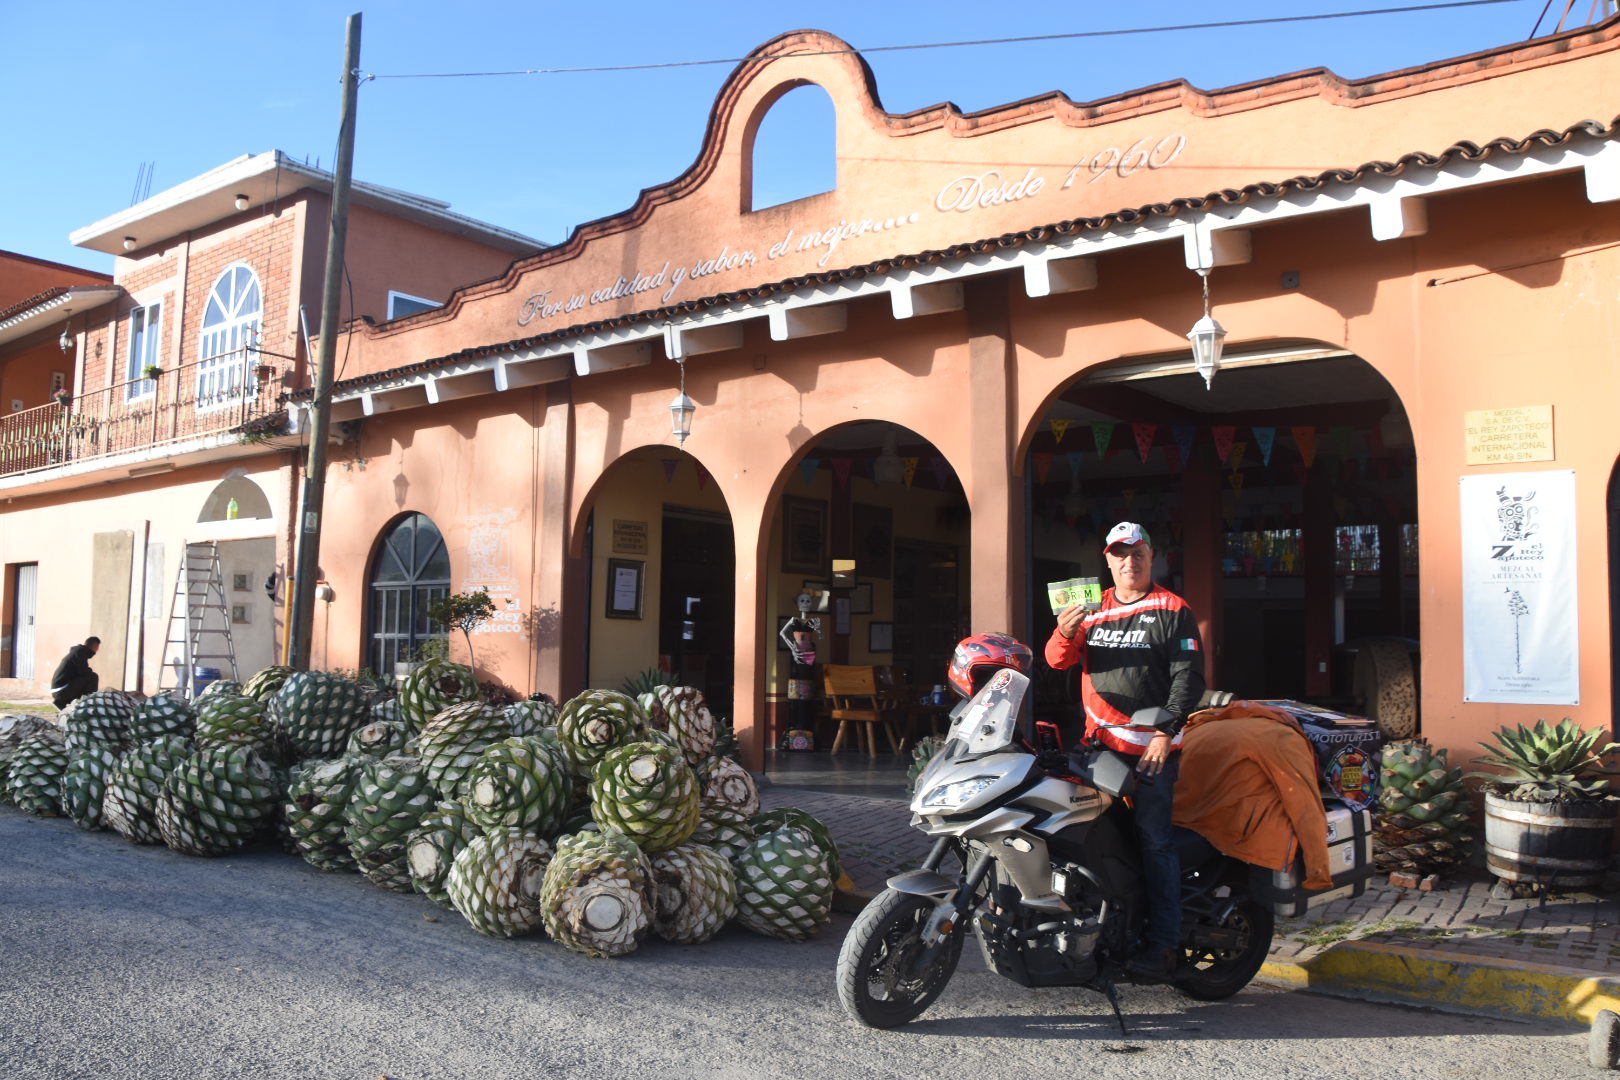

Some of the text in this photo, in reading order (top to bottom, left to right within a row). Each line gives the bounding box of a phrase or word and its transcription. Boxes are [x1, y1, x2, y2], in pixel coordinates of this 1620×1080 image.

[518, 290, 562, 325] Por
[565, 295, 585, 312] su
[590, 261, 671, 305] calidad
[662, 266, 687, 303] y
[689, 246, 759, 280] sabor,
[767, 229, 794, 260] el
[935, 167, 1046, 212] Desde
[1060, 133, 1187, 190] 1960
[1480, 432, 1539, 443] CARRETERA
[1471, 441, 1548, 453] INTERNACIONAL
[493, 611, 521, 623] Rey
[1092, 627, 1147, 643] DUCATI
